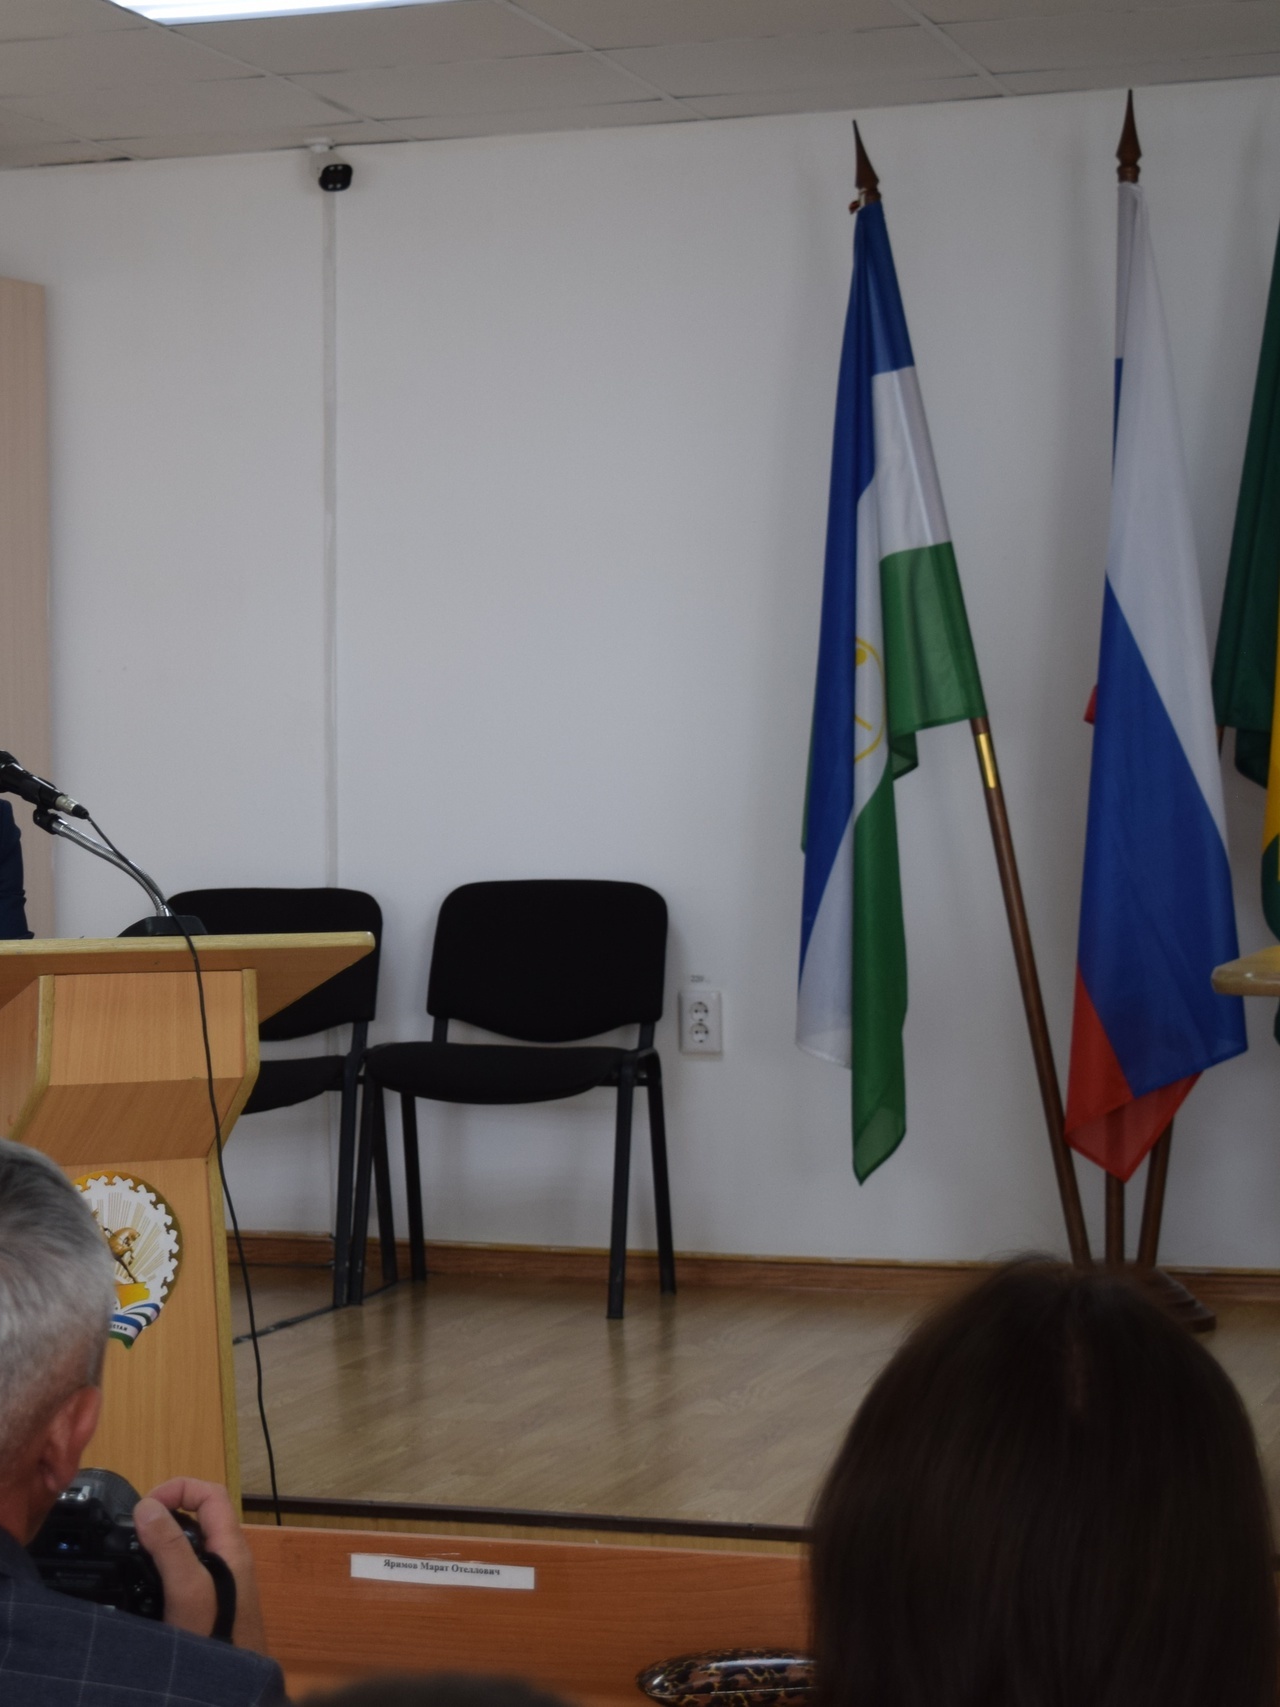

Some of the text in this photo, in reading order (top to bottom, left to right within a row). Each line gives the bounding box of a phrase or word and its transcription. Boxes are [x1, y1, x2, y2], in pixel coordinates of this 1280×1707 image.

[383, 1559, 501, 1576] Яримов Марат Отеллович
